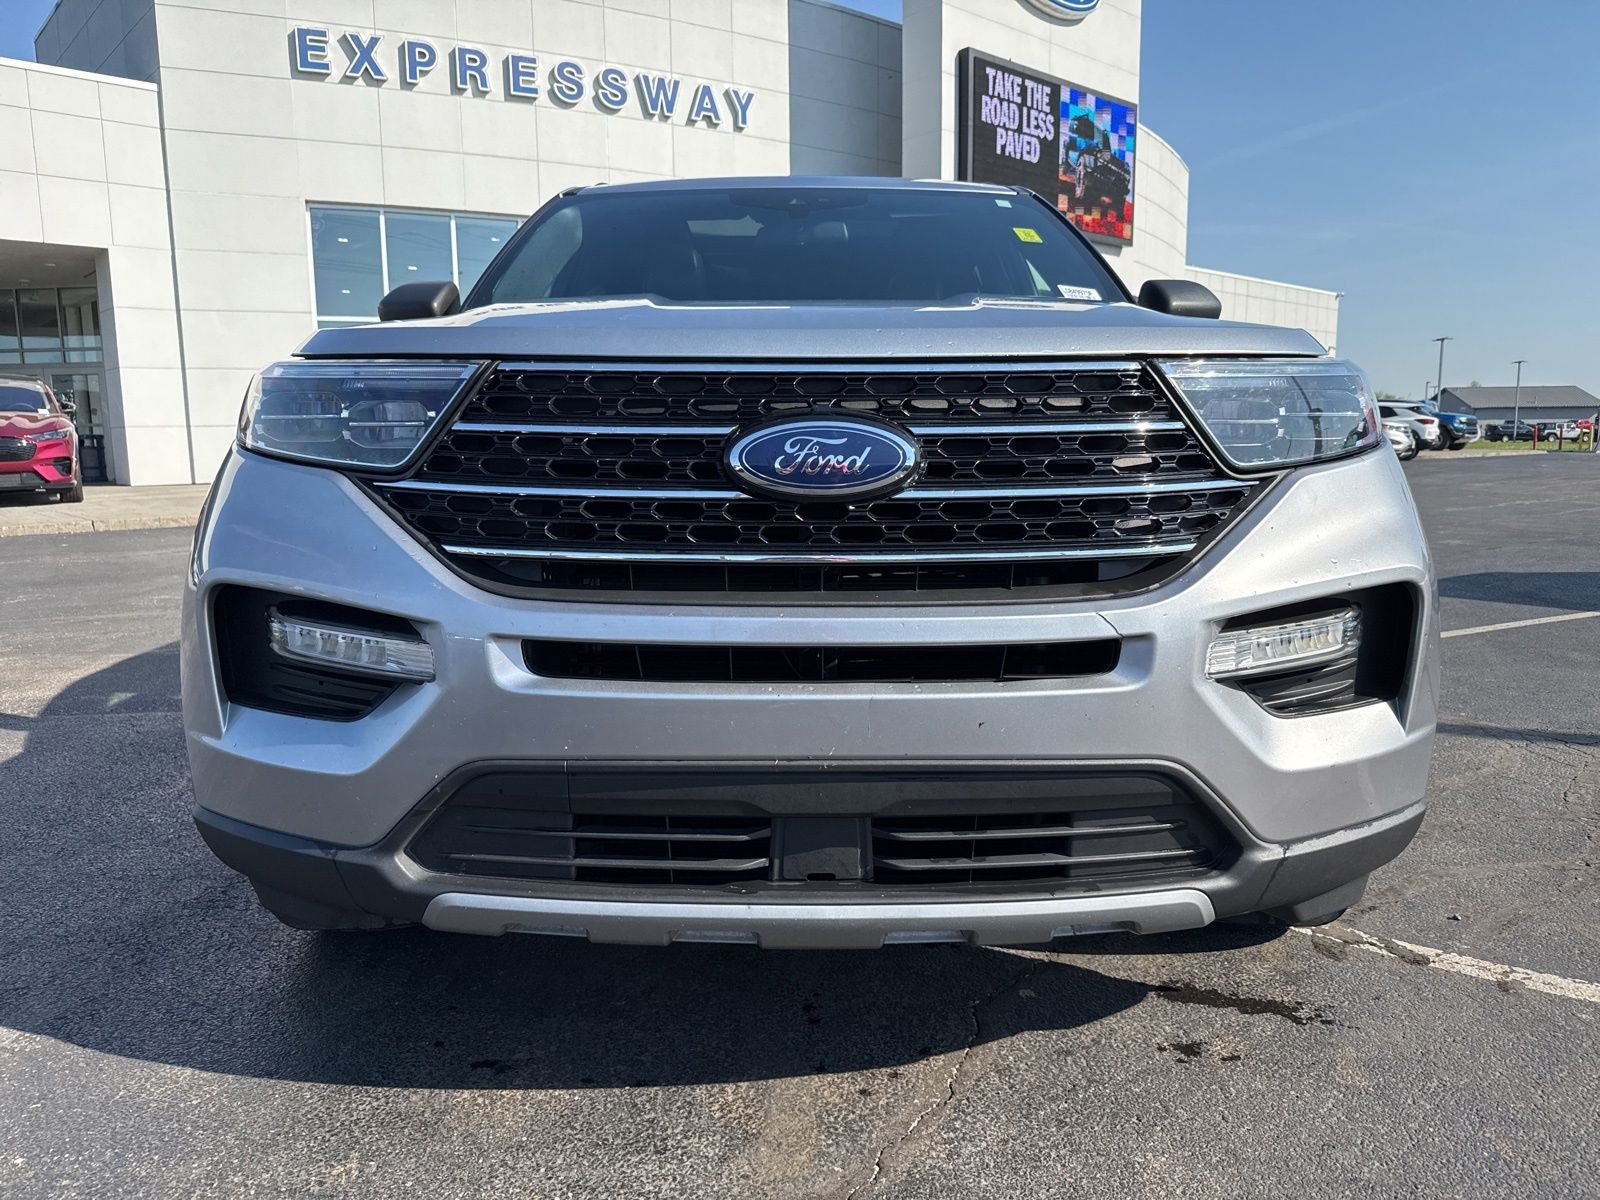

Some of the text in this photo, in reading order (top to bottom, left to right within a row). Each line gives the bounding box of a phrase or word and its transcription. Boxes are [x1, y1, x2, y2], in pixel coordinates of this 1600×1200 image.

[292, 27, 756, 129] EXPRESSWAY
[985, 67, 1051, 113] TAKE THE
[981, 95, 1055, 141] ROAD LESS
[995, 128, 1041, 163] PAVED
[774, 436, 872, 475] Ford
